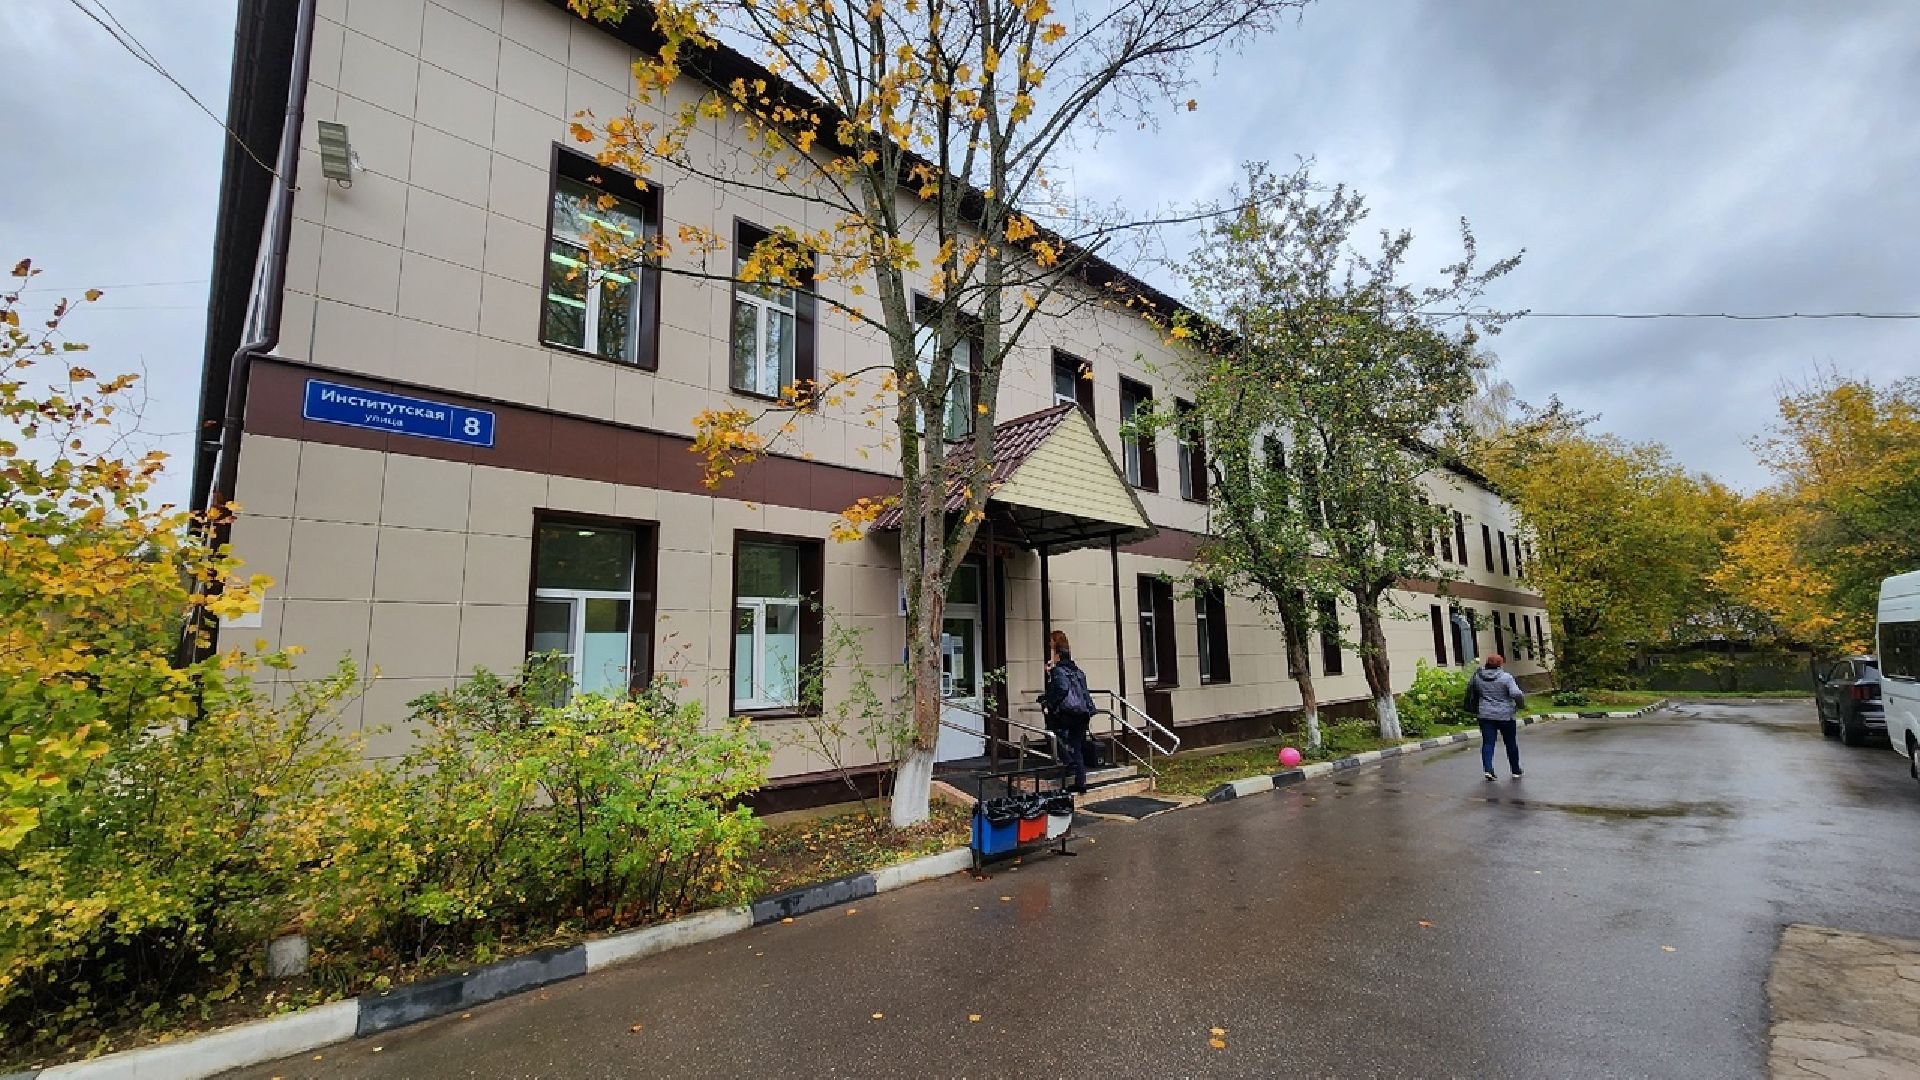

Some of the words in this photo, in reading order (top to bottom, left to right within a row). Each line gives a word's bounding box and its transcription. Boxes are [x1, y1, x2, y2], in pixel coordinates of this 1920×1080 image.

[321, 389, 445, 421] Институтская
[364, 414, 403, 427] улица
[463, 417, 481, 436] 8
